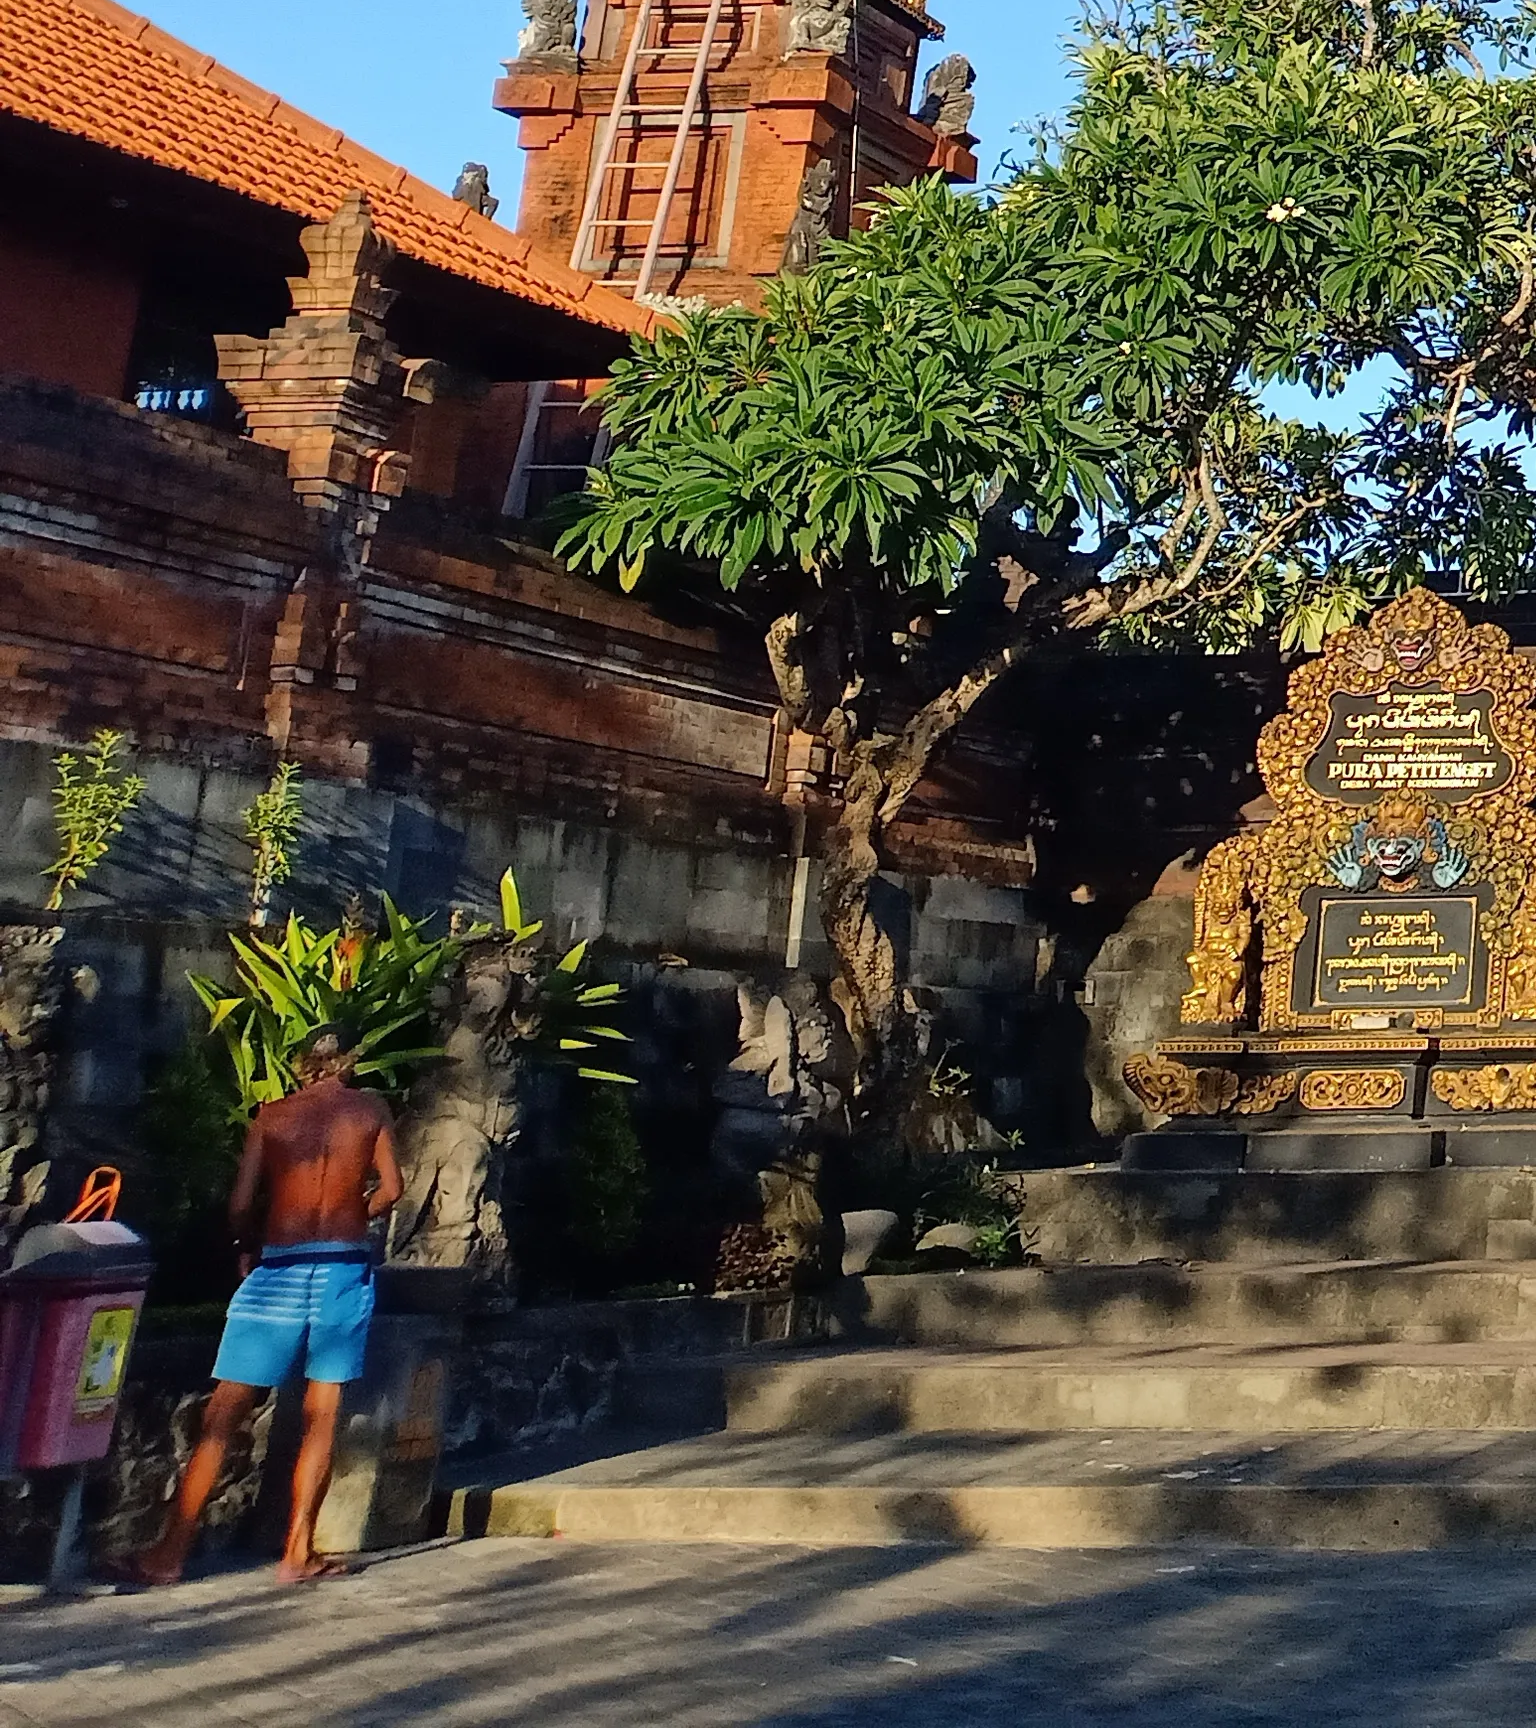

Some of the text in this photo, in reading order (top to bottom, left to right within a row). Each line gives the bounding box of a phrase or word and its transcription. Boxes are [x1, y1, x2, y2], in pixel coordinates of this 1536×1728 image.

[1328, 762, 1497, 779] PURA PETITENGET
[1340, 779, 1370, 789] DESA
[1374, 779, 1405, 788] ADAT
